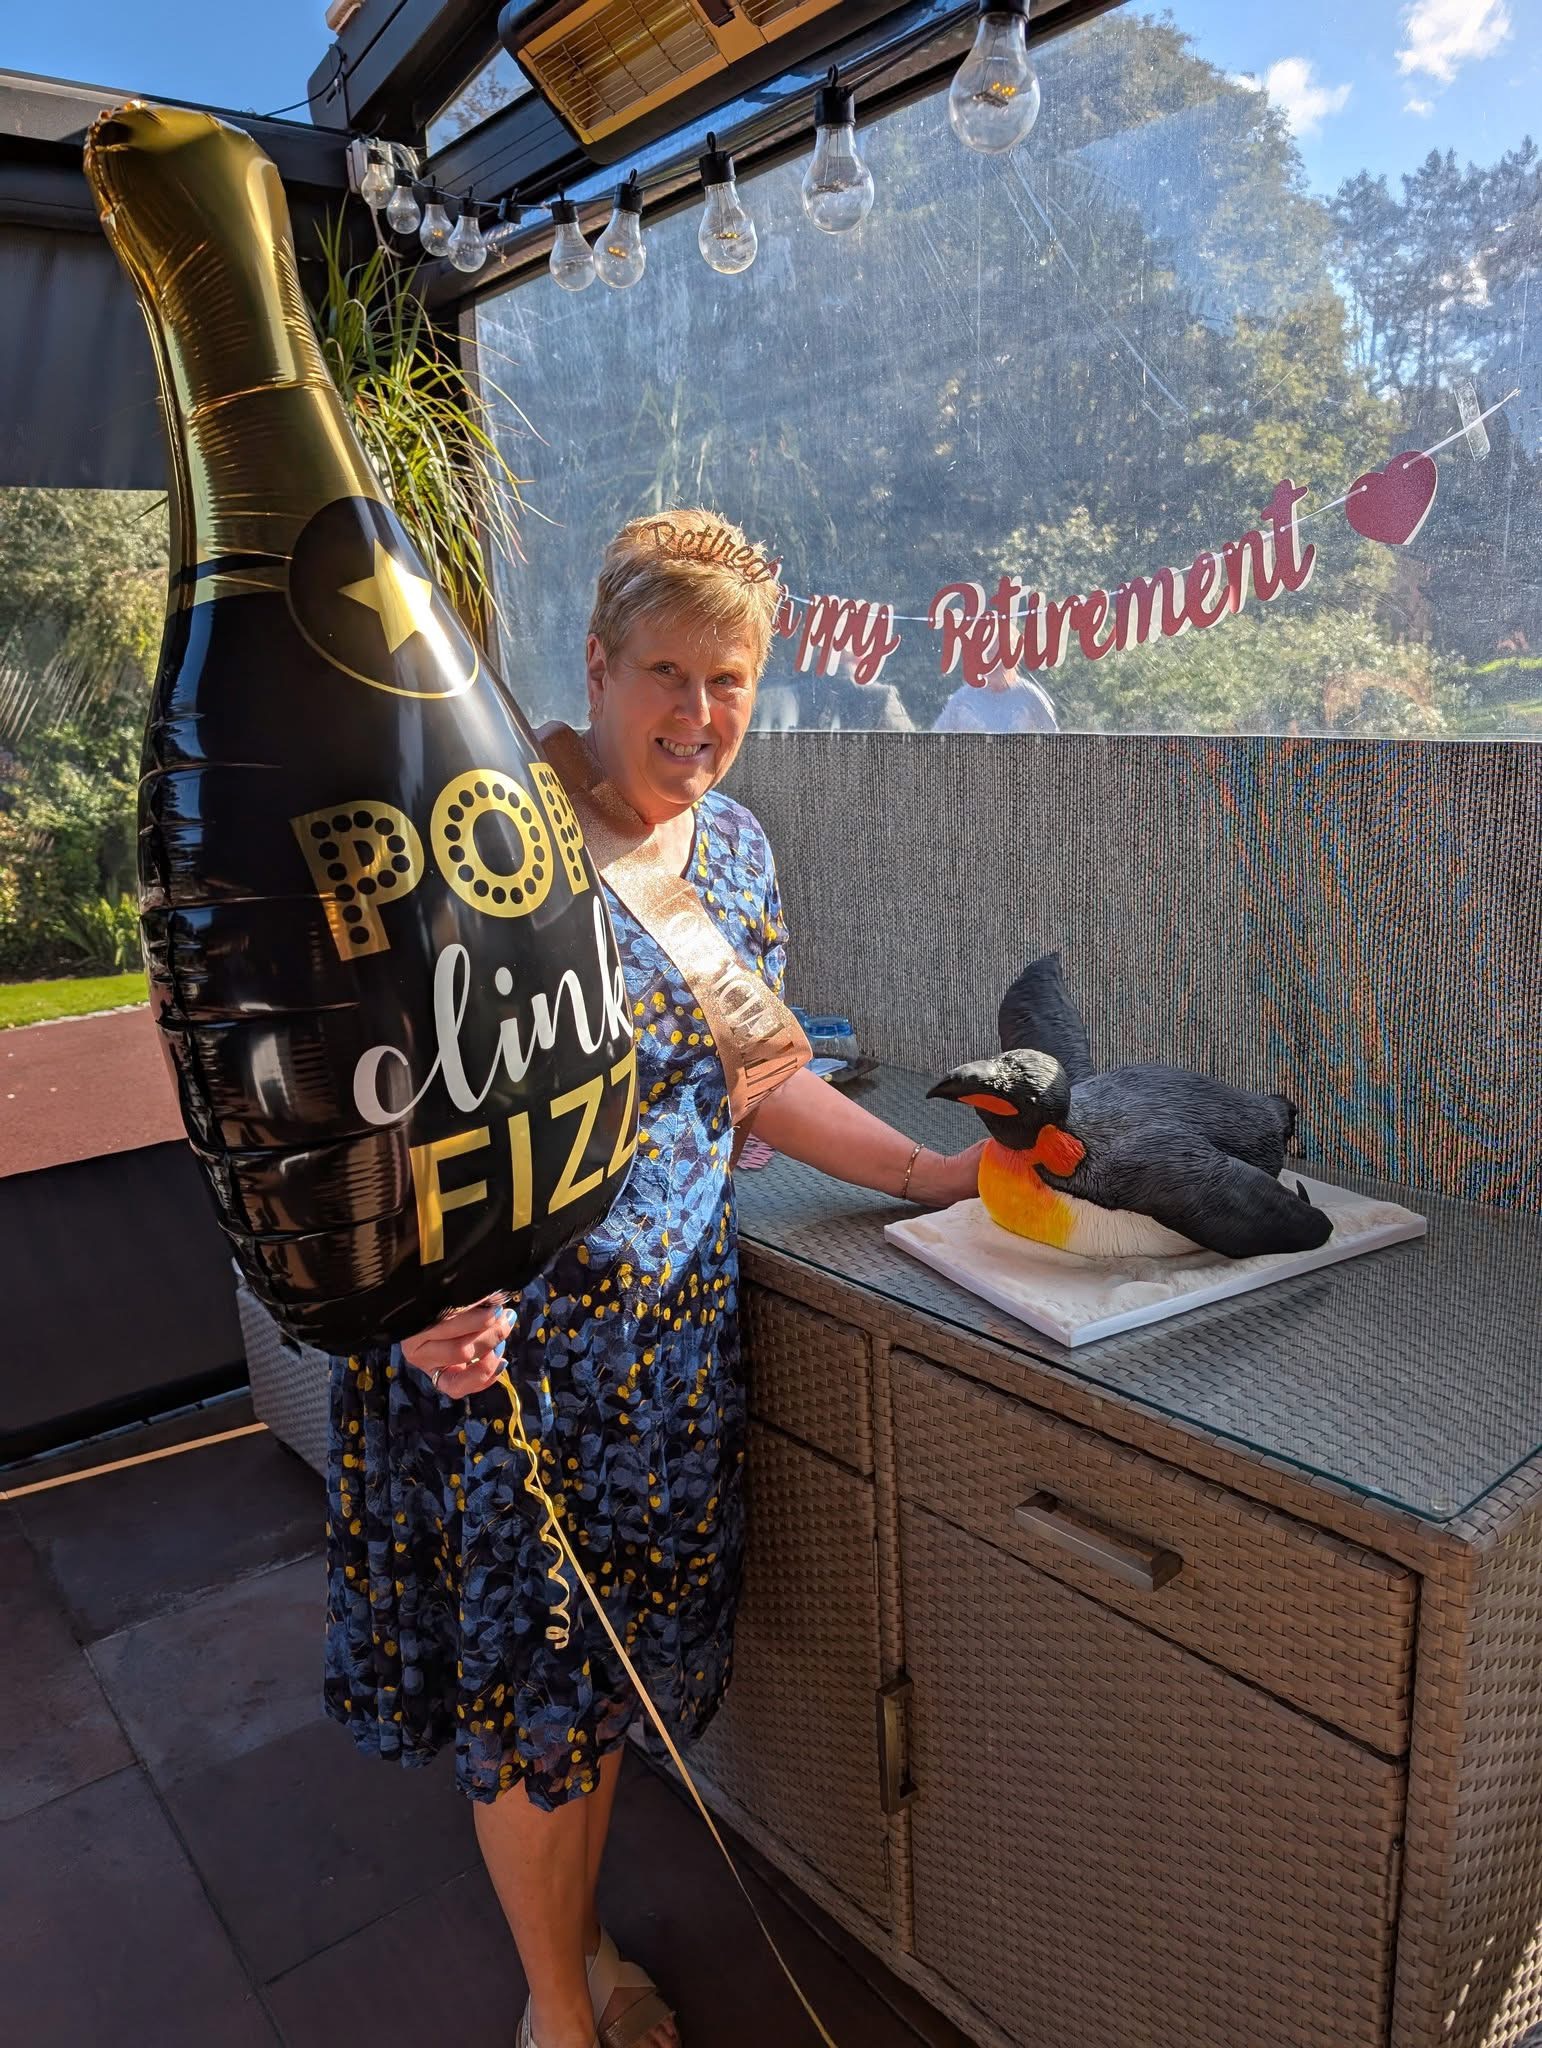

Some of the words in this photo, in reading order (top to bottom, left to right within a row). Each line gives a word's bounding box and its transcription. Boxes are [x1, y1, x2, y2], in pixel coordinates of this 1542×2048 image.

[638, 520, 783, 584] Retired
[768, 557, 902, 686] appy
[928, 478, 1318, 689] Retirement
[289, 762, 590, 962] POP
[353, 895, 635, 1126] clink
[408, 1050, 638, 1266] FIZZ
